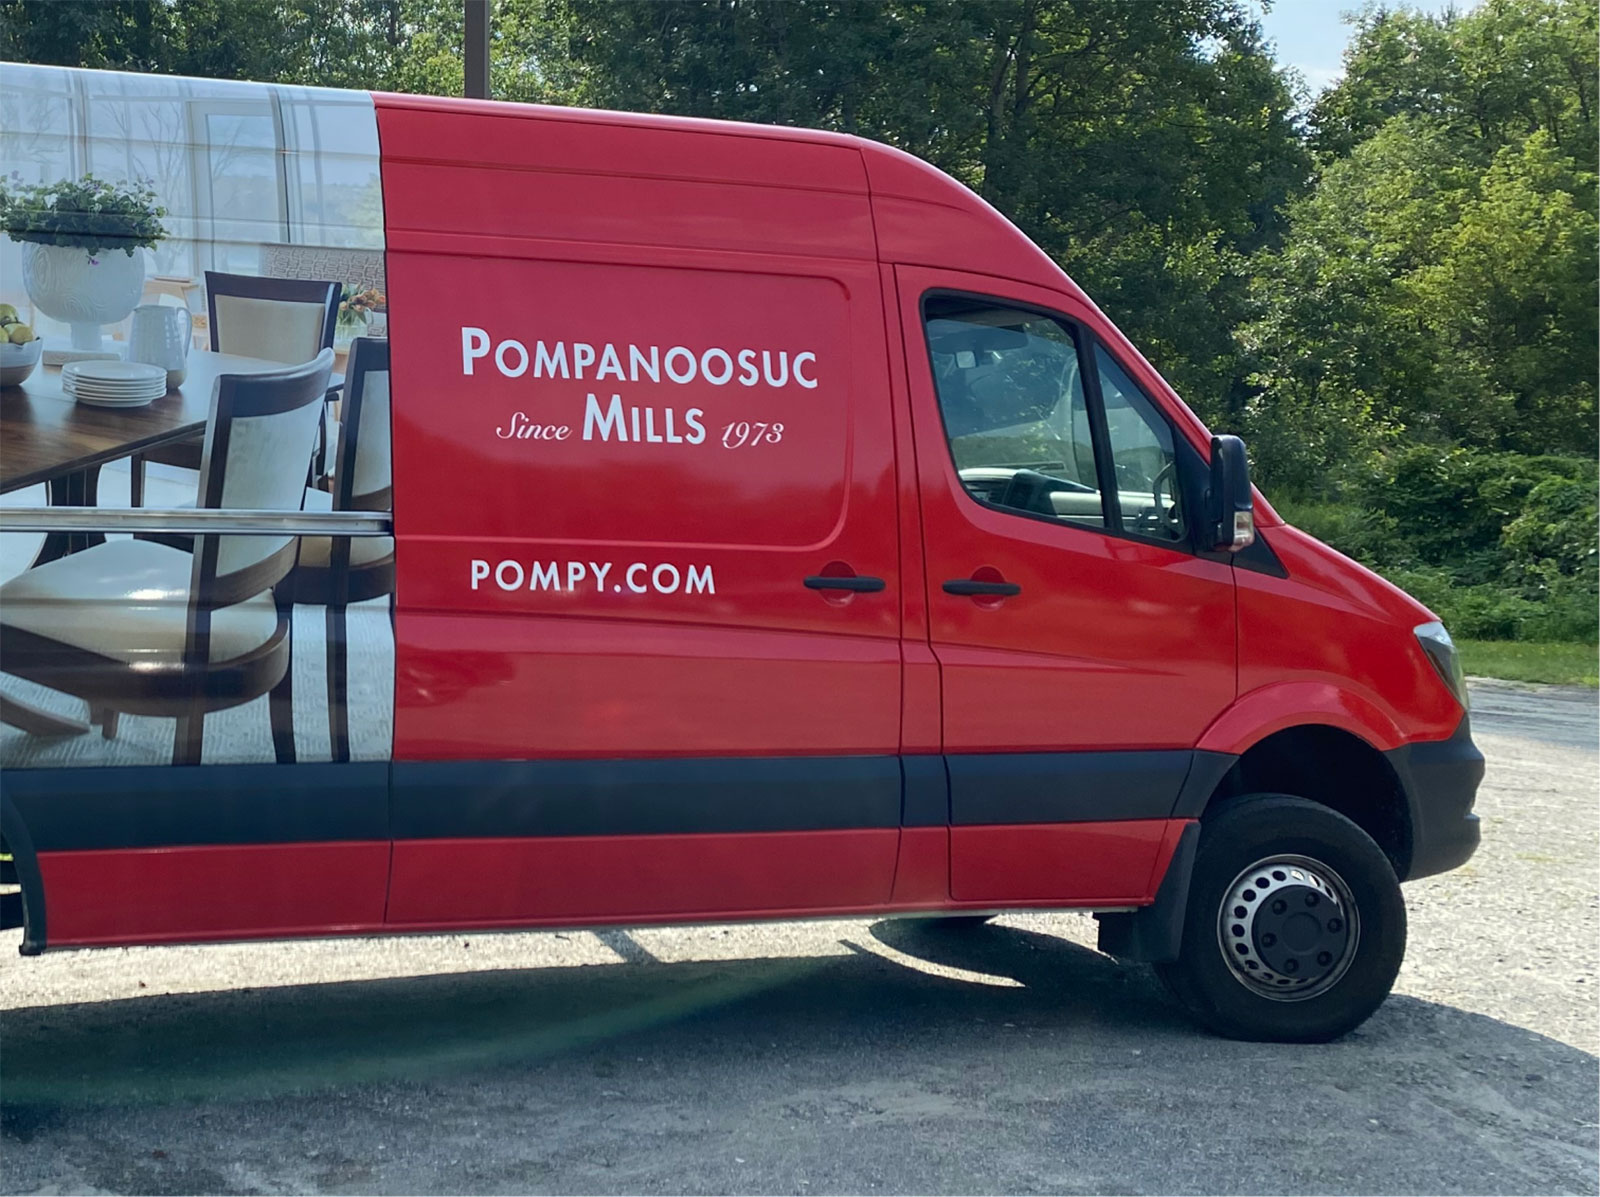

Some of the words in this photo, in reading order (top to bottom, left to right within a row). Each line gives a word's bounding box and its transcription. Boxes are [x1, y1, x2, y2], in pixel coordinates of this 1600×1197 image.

[461, 326, 818, 389] POMPANOOSUC
[496, 412, 572, 441] Since
[582, 393, 706, 445] MILLS
[721, 421, 785, 449] 1973
[470, 559, 716, 594] POMPY.COM
